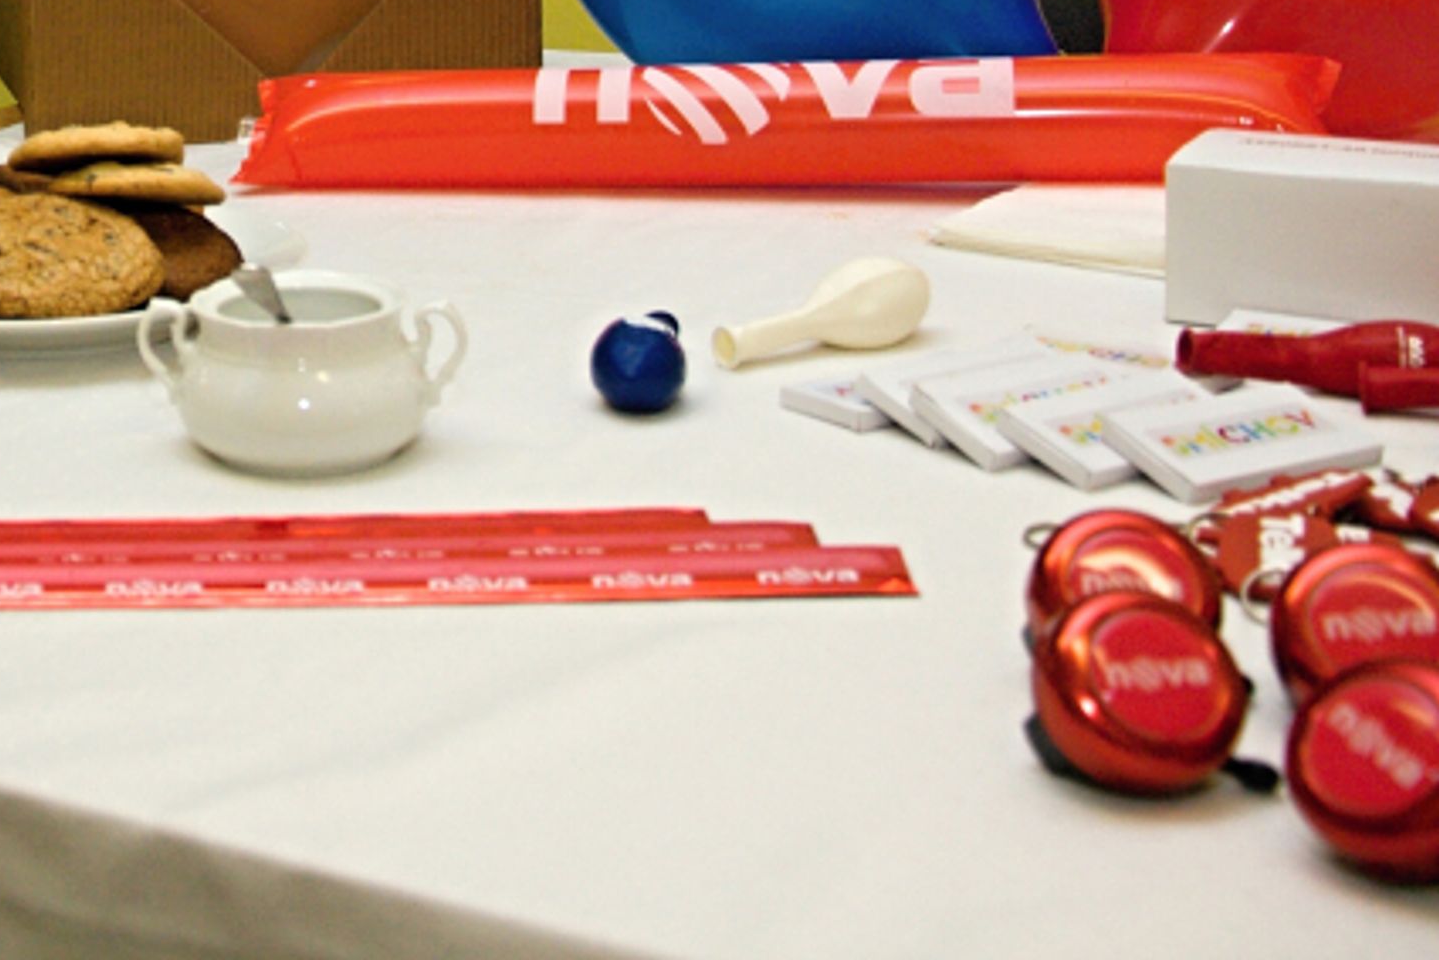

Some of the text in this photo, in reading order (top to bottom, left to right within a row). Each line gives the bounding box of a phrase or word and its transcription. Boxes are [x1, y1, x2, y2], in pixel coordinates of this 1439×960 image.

[105, 579, 203, 597] nova
[265, 577, 364, 594] nova
[427, 573, 529, 591] nova
[591, 570, 693, 589] nova
[756, 566, 859, 586] nova
[1321, 607, 1437, 641] nova
[1105, 655, 1211, 692] nova
